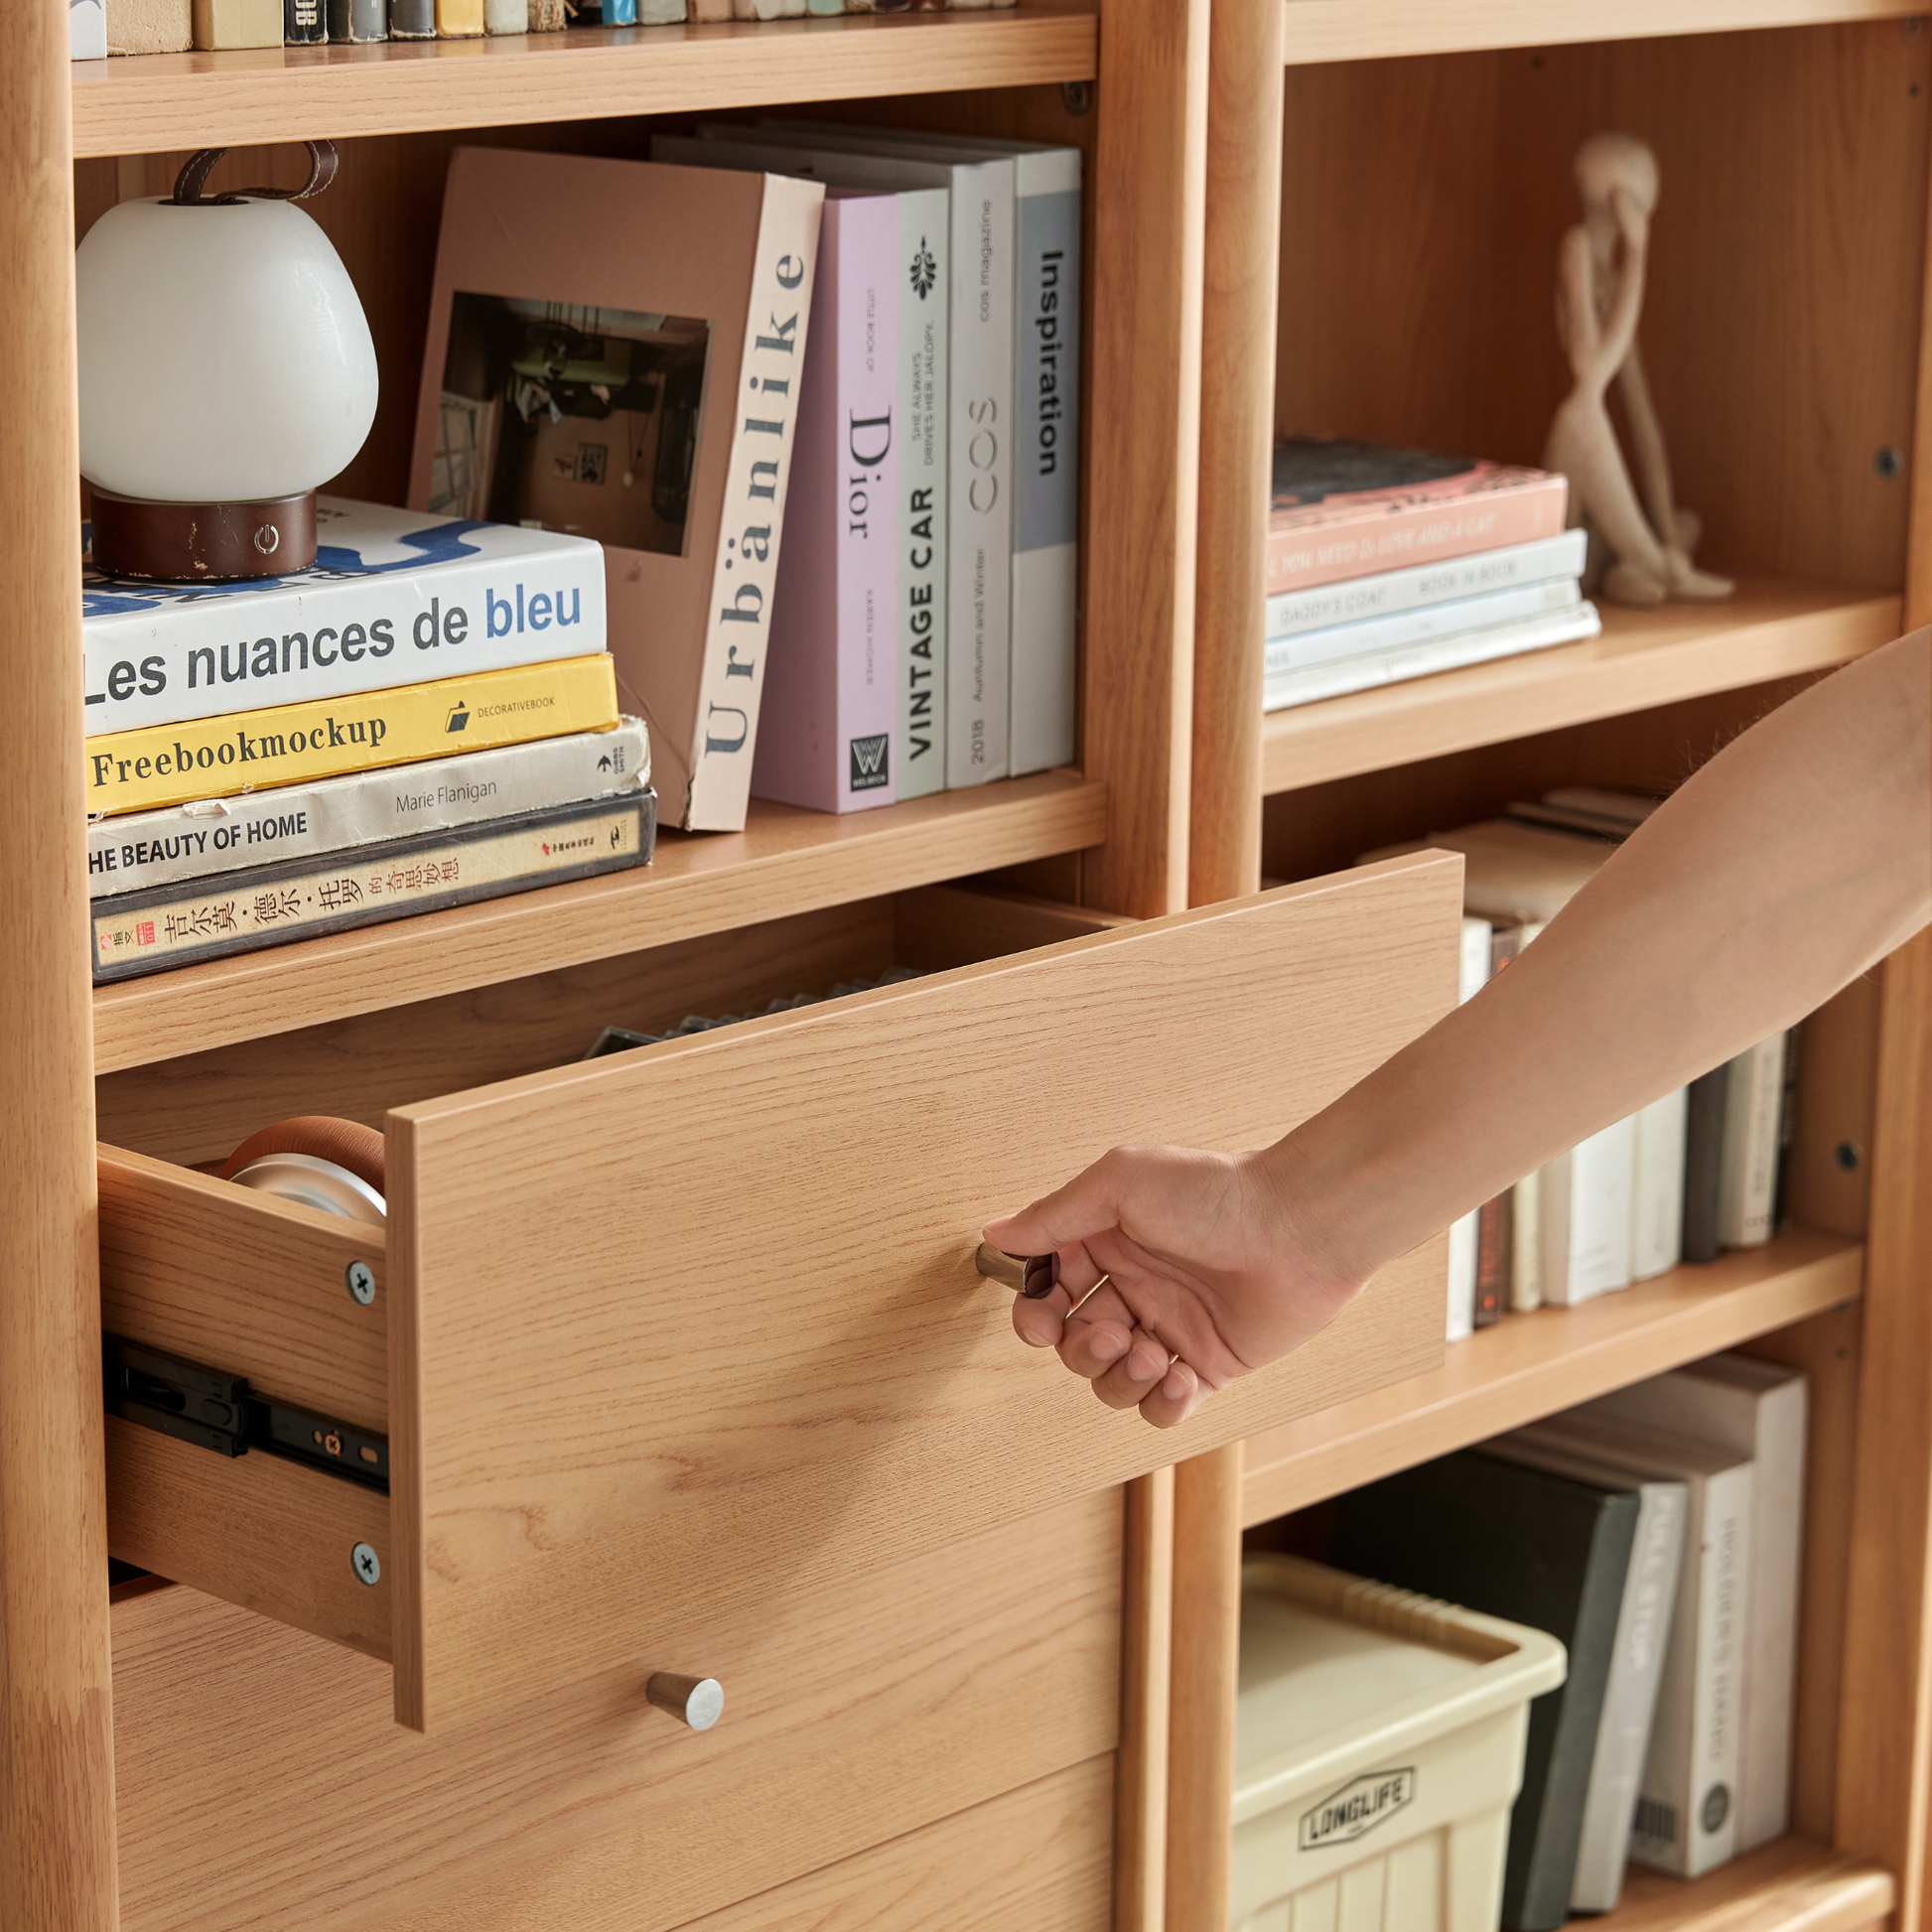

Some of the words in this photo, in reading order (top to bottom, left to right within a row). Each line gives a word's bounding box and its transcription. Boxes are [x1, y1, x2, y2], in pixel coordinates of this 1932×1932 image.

[980, 199, 993, 286] magazine
[979, 289, 990, 323] cos
[911, 350, 922, 410] ALWAYS
[1035, 249, 1064, 477] Inspiration
[924, 379, 934, 411] HER
[911, 411, 921, 442] SHE
[923, 413, 934, 466] DRIVES
[968, 396, 998, 514] COS
[849, 404, 892, 540] Dior
[704, 253, 804, 759] Urbänlike
[910, 486, 932, 570] CAR
[973, 548, 986, 600] Winter
[1282, 552, 1313, 574] YOU
[1317, 539, 1360, 567] NEED
[1378, 528, 1417, 557] LOVE
[1417, 521, 1449, 546] AND
[188, 618, 395, 689] nuances
[413, 597, 469, 650] de
[485, 584, 581, 639] bleu
[974, 601, 985, 630] and
[909, 583, 932, 761] VINTAGE
[478, 696, 555, 718] DECORATIVEBOOK
[90, 716, 387, 787] Freebookmockup
[971, 718, 986, 765] 2018
[396, 791, 435, 813] Marie
[437, 780, 497, 804] Flanigan
[88, 848, 118, 875] HE
[121, 830, 208, 869] BEAUTY
[212, 824, 241, 851] OF
[247, 811, 308, 844] HOME
[146, 923, 155, 942] 011
[1310, 1773, 1403, 1841] LONGLIFE
